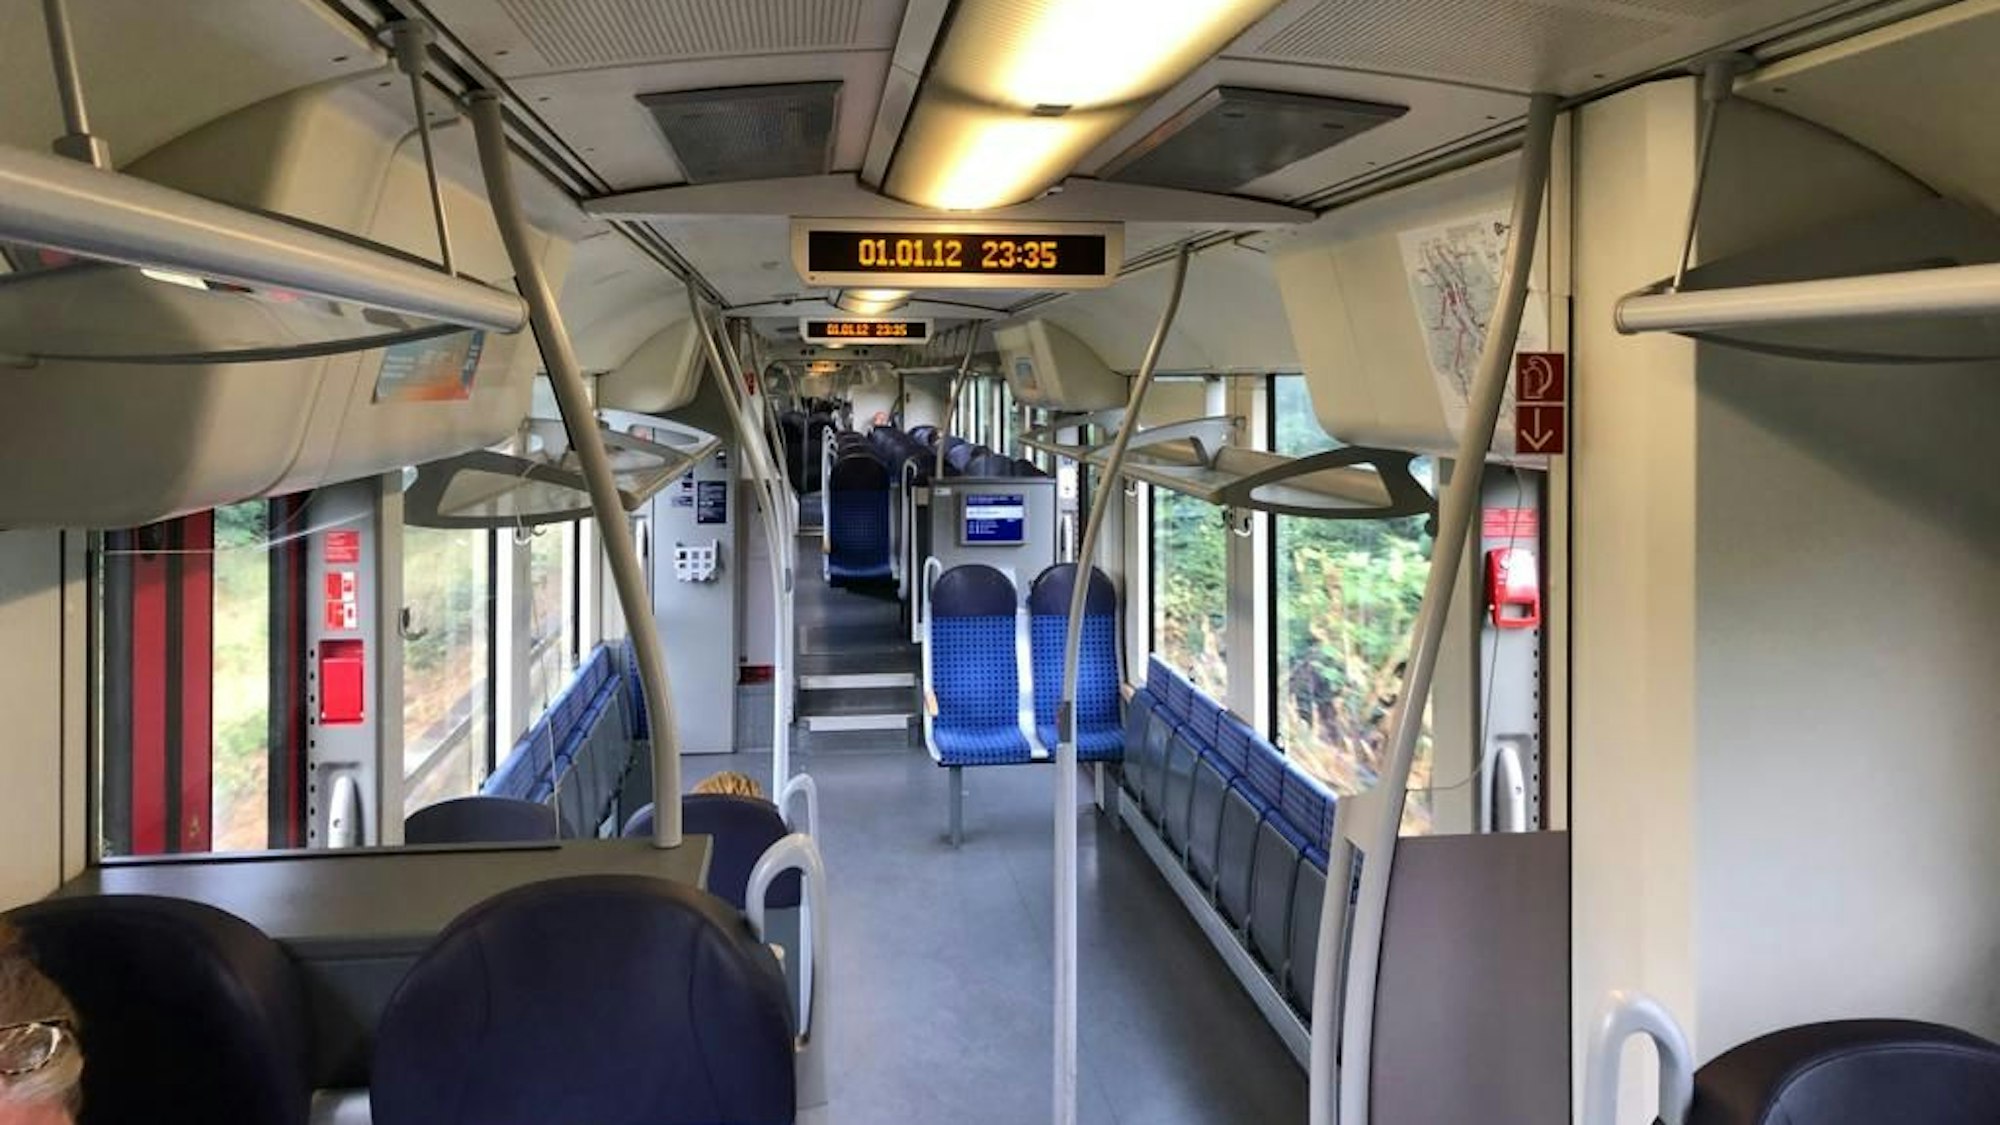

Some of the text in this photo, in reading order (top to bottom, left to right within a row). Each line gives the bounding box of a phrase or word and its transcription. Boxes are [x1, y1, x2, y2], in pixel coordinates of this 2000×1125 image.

[858, 239, 1058, 268] 01.01.12 23:35
[826, 323, 907, 336] 01.01.12 23:35
